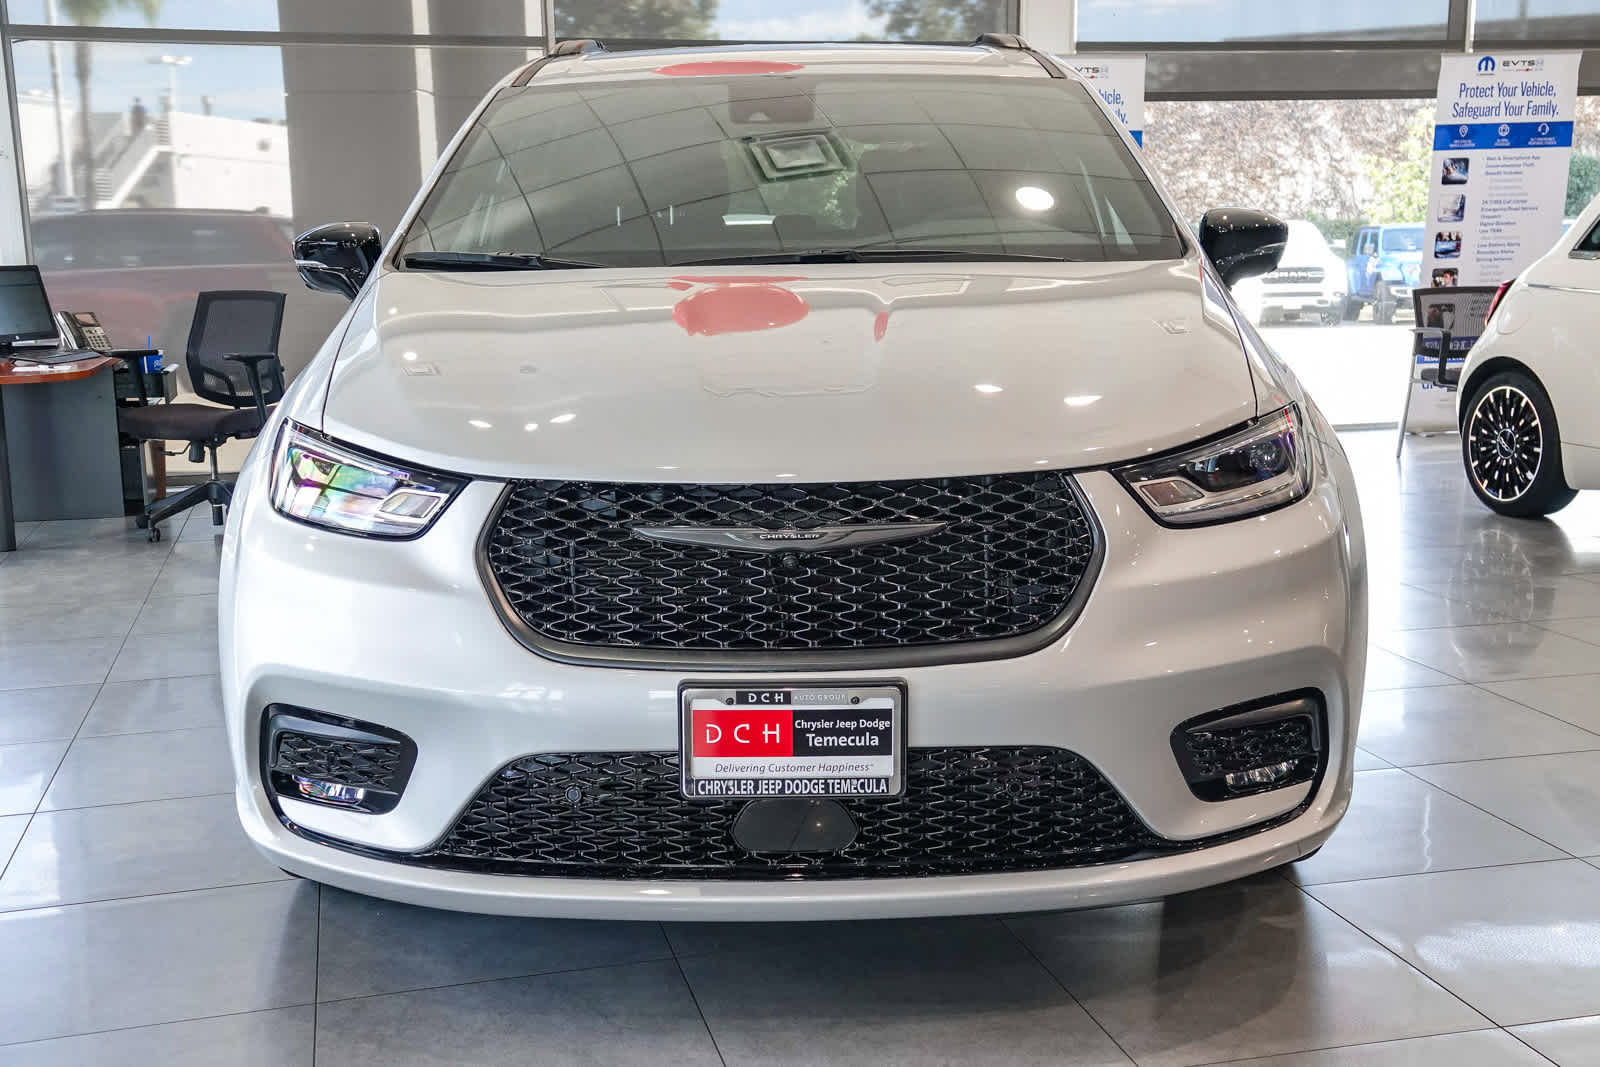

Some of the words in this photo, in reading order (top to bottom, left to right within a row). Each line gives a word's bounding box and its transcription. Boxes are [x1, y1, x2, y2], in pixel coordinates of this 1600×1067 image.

[1098, 89, 1124, 105] hicle,
[1459, 82, 1494, 98] Protect
[1497, 82, 1518, 98] Your
[1520, 81, 1557, 97] Vehicle,
[1452, 102, 1501, 119] Safeguard
[1504, 101, 1525, 117] Your
[1526, 100, 1559, 117] Family.
[795, 719, 833, 731] Chrysler
[835, 719, 857, 731] Jeep
[859, 719, 891, 730] Dodge
[806, 732, 879, 747] Temecula
[715, 763, 766, 774] Delivering
[768, 763, 816, 773] Customer
[698, 780, 754, 795] CHRYSLER
[756, 779, 782, 795] JEEP
[785, 779, 825, 794] DODGE
[827, 779, 888, 794] TEMECULA
